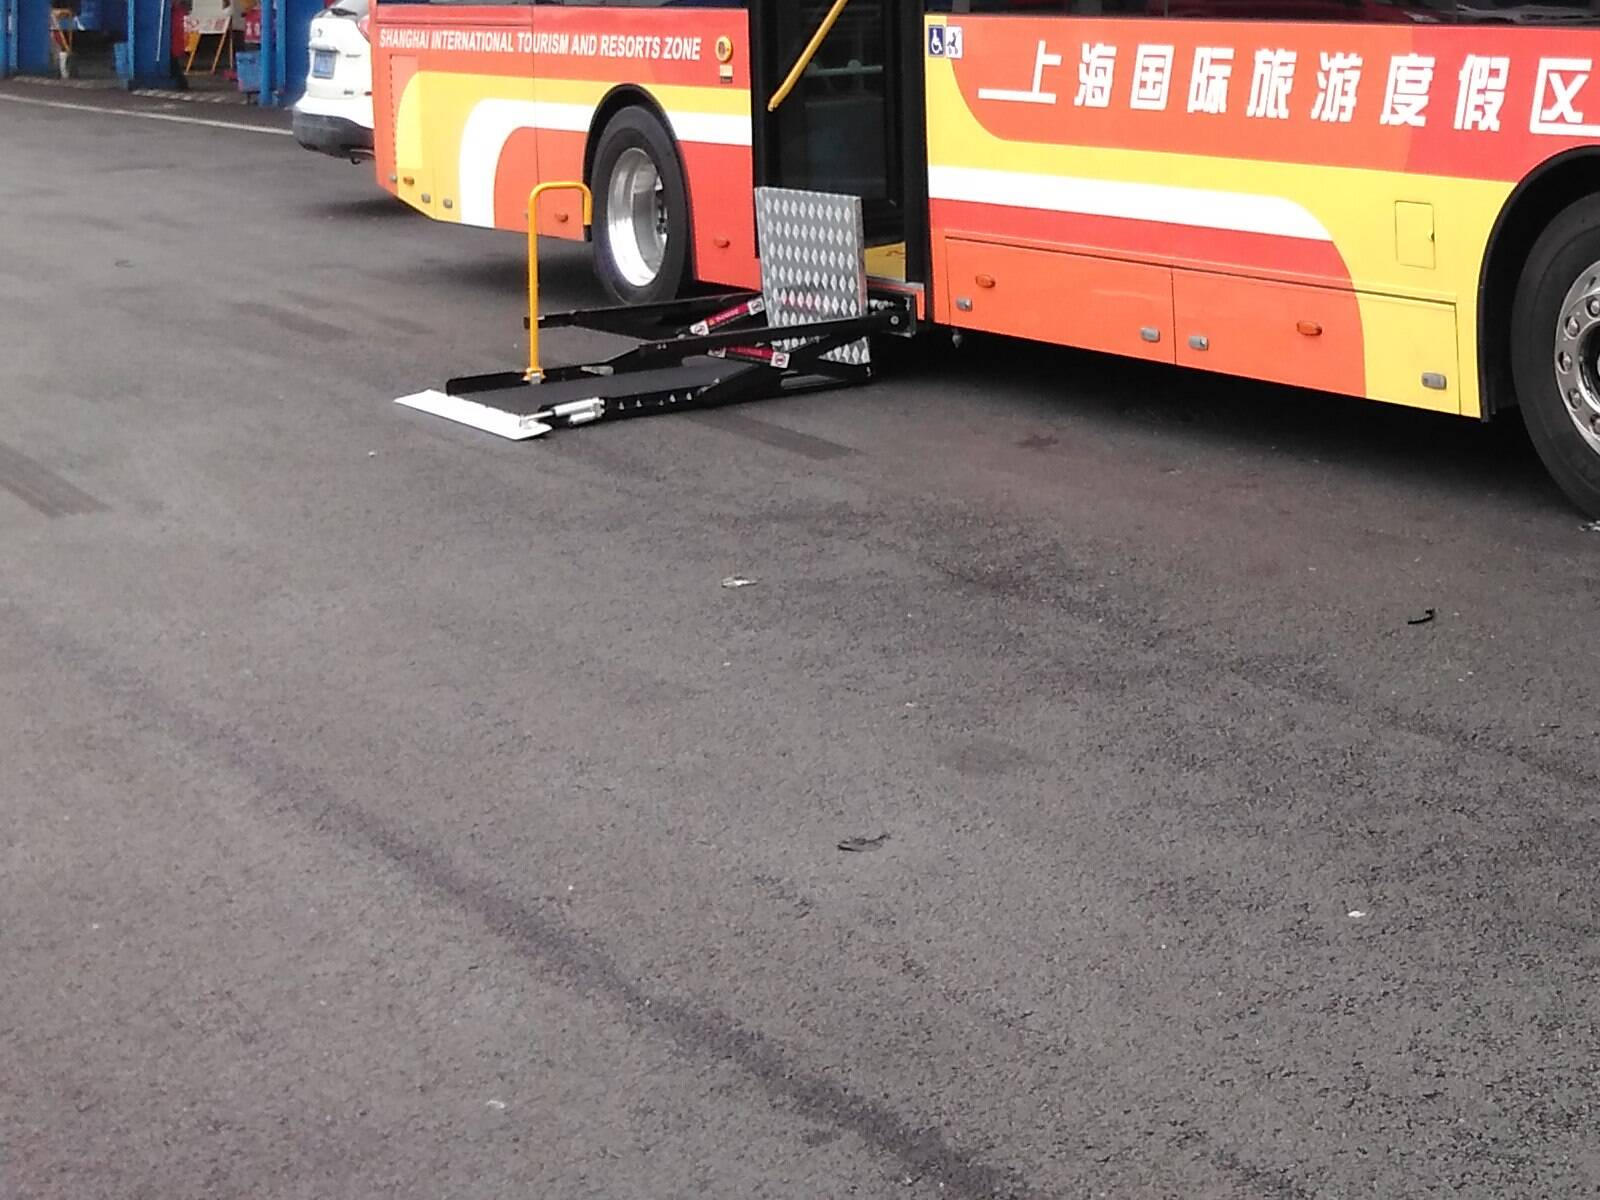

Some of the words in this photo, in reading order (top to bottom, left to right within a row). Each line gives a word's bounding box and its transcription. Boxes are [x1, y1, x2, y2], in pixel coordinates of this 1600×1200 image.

[379, 29, 430, 49] SHANGHAI
[431, 30, 514, 52] INTERNATIONAL
[517, 32, 569, 54] TOURISM
[571, 35, 598, 56] AND
[600, 36, 661, 58] RESORTS
[663, 38, 702, 60] ZONE
